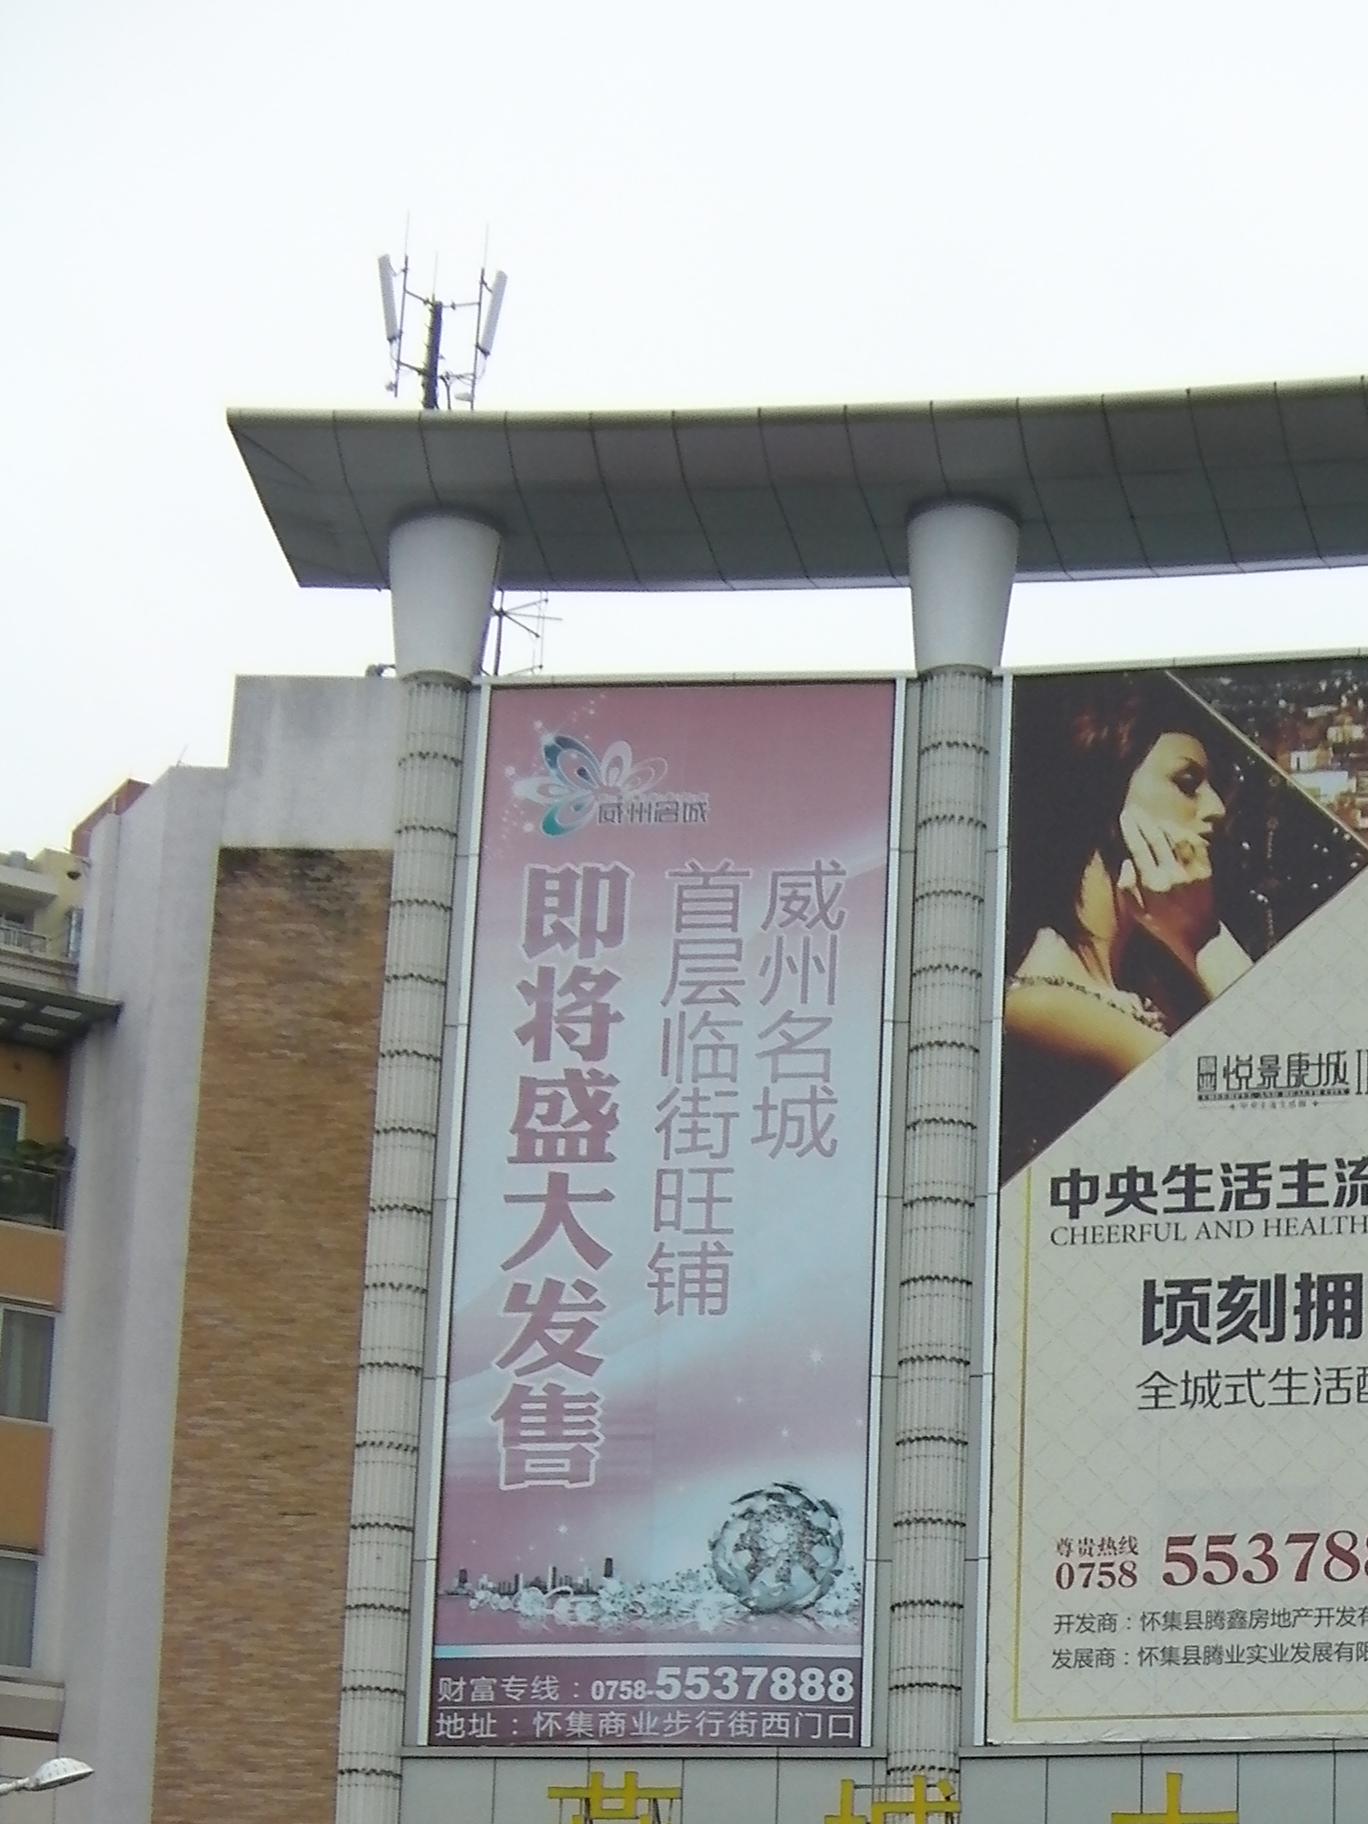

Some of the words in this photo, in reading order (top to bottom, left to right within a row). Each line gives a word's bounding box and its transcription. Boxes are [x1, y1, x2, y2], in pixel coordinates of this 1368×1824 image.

[647, 858, 751, 1317] 首层临街旺铺
[751, 858, 847, 1160] 威州名城
[491, 862, 632, 1490] 即将盛大发售
[1050, 1221, 1188, 1247] CHEERFUL
[1195, 1219, 1255, 1241] AND
[1055, 1560, 1138, 1590] 0758
[1056, 1535, 1140, 1558] 尊贵热线
